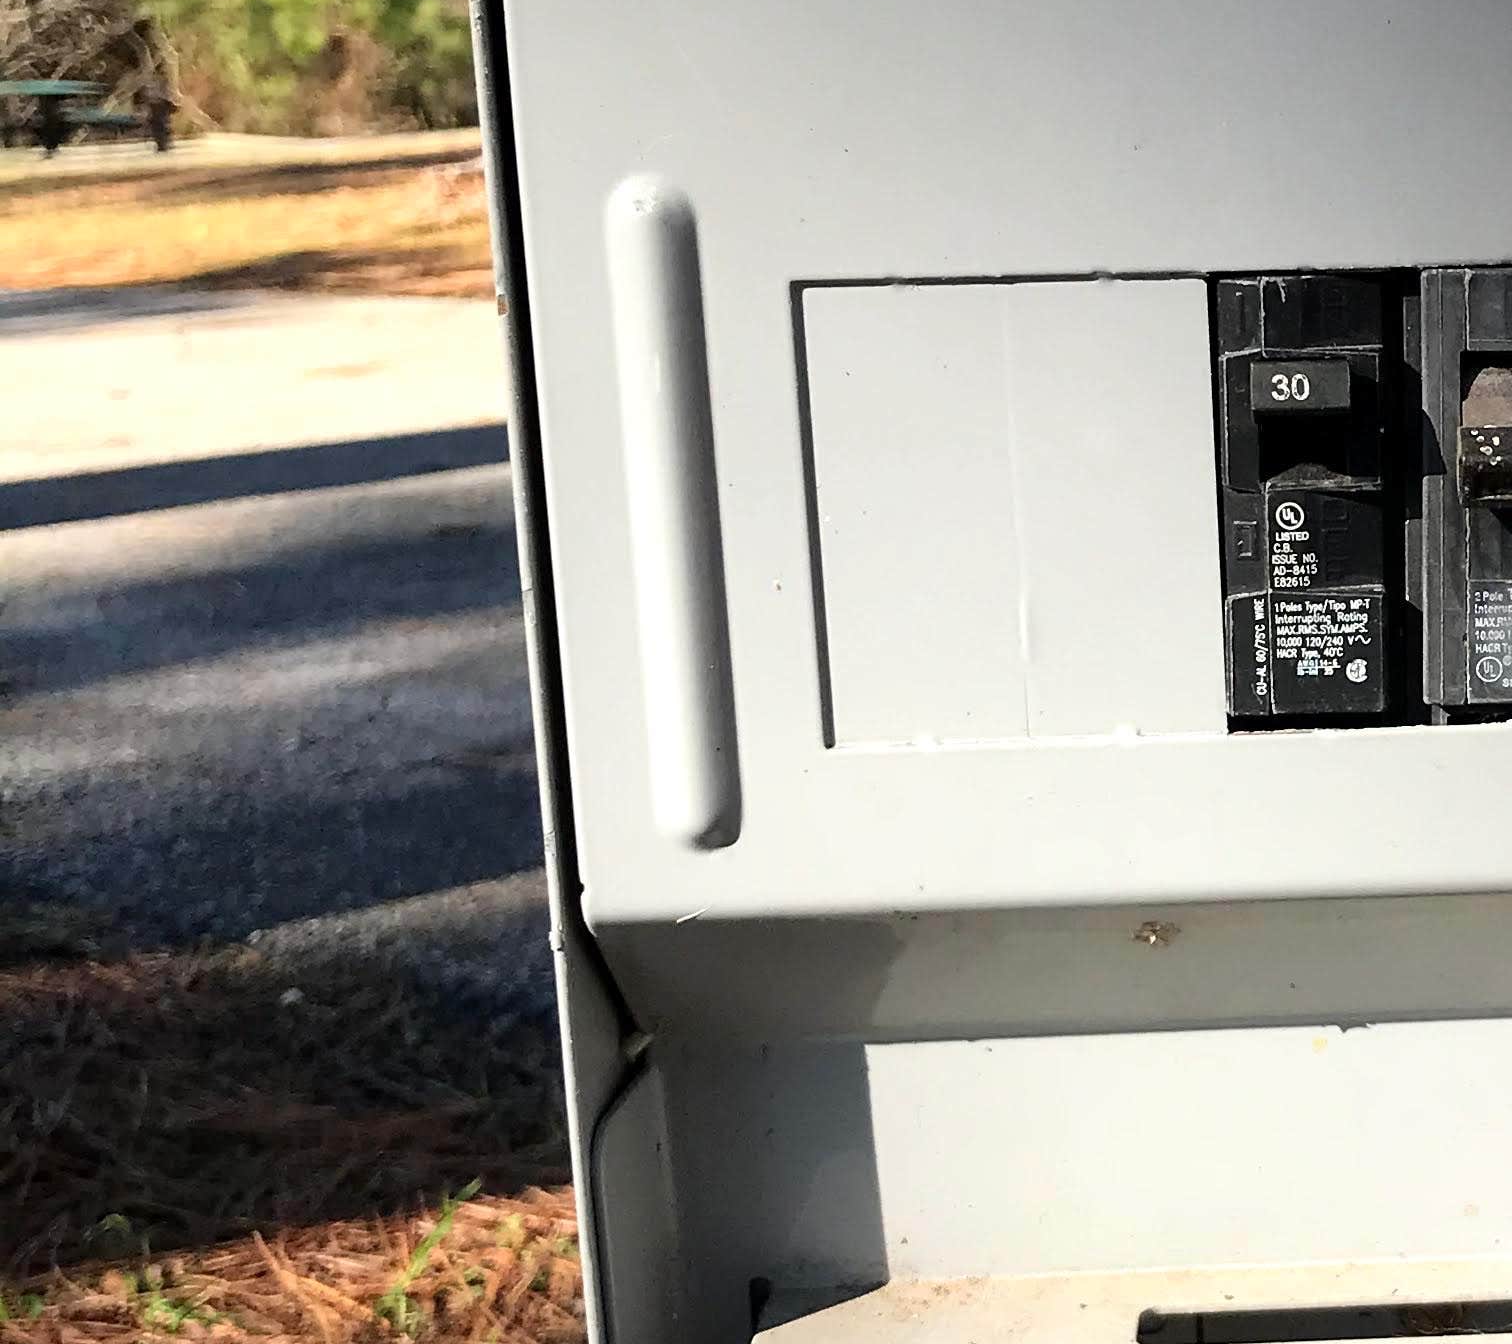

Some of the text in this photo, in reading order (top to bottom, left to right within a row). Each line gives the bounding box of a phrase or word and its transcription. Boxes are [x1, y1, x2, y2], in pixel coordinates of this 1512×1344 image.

[1270, 372, 1310, 402] 30
[1275, 530, 1310, 542] LISTED
[1273, 543, 1294, 554] C.B.
[1271, 552, 1319, 565] ISSUE NO.
[1273, 564, 1318, 576] AD-8415
[1274, 575, 1311, 588] E82615
[1253, 598, 1265, 621] WIRE
[1274, 611, 1369, 626] Interrupting Rating
[1276, 636, 1303, 648] 10,000
[1305, 635, 1344, 649] 120/240
[1475, 643, 1501, 654] HACR
[1276, 648, 1298, 659] HACR
